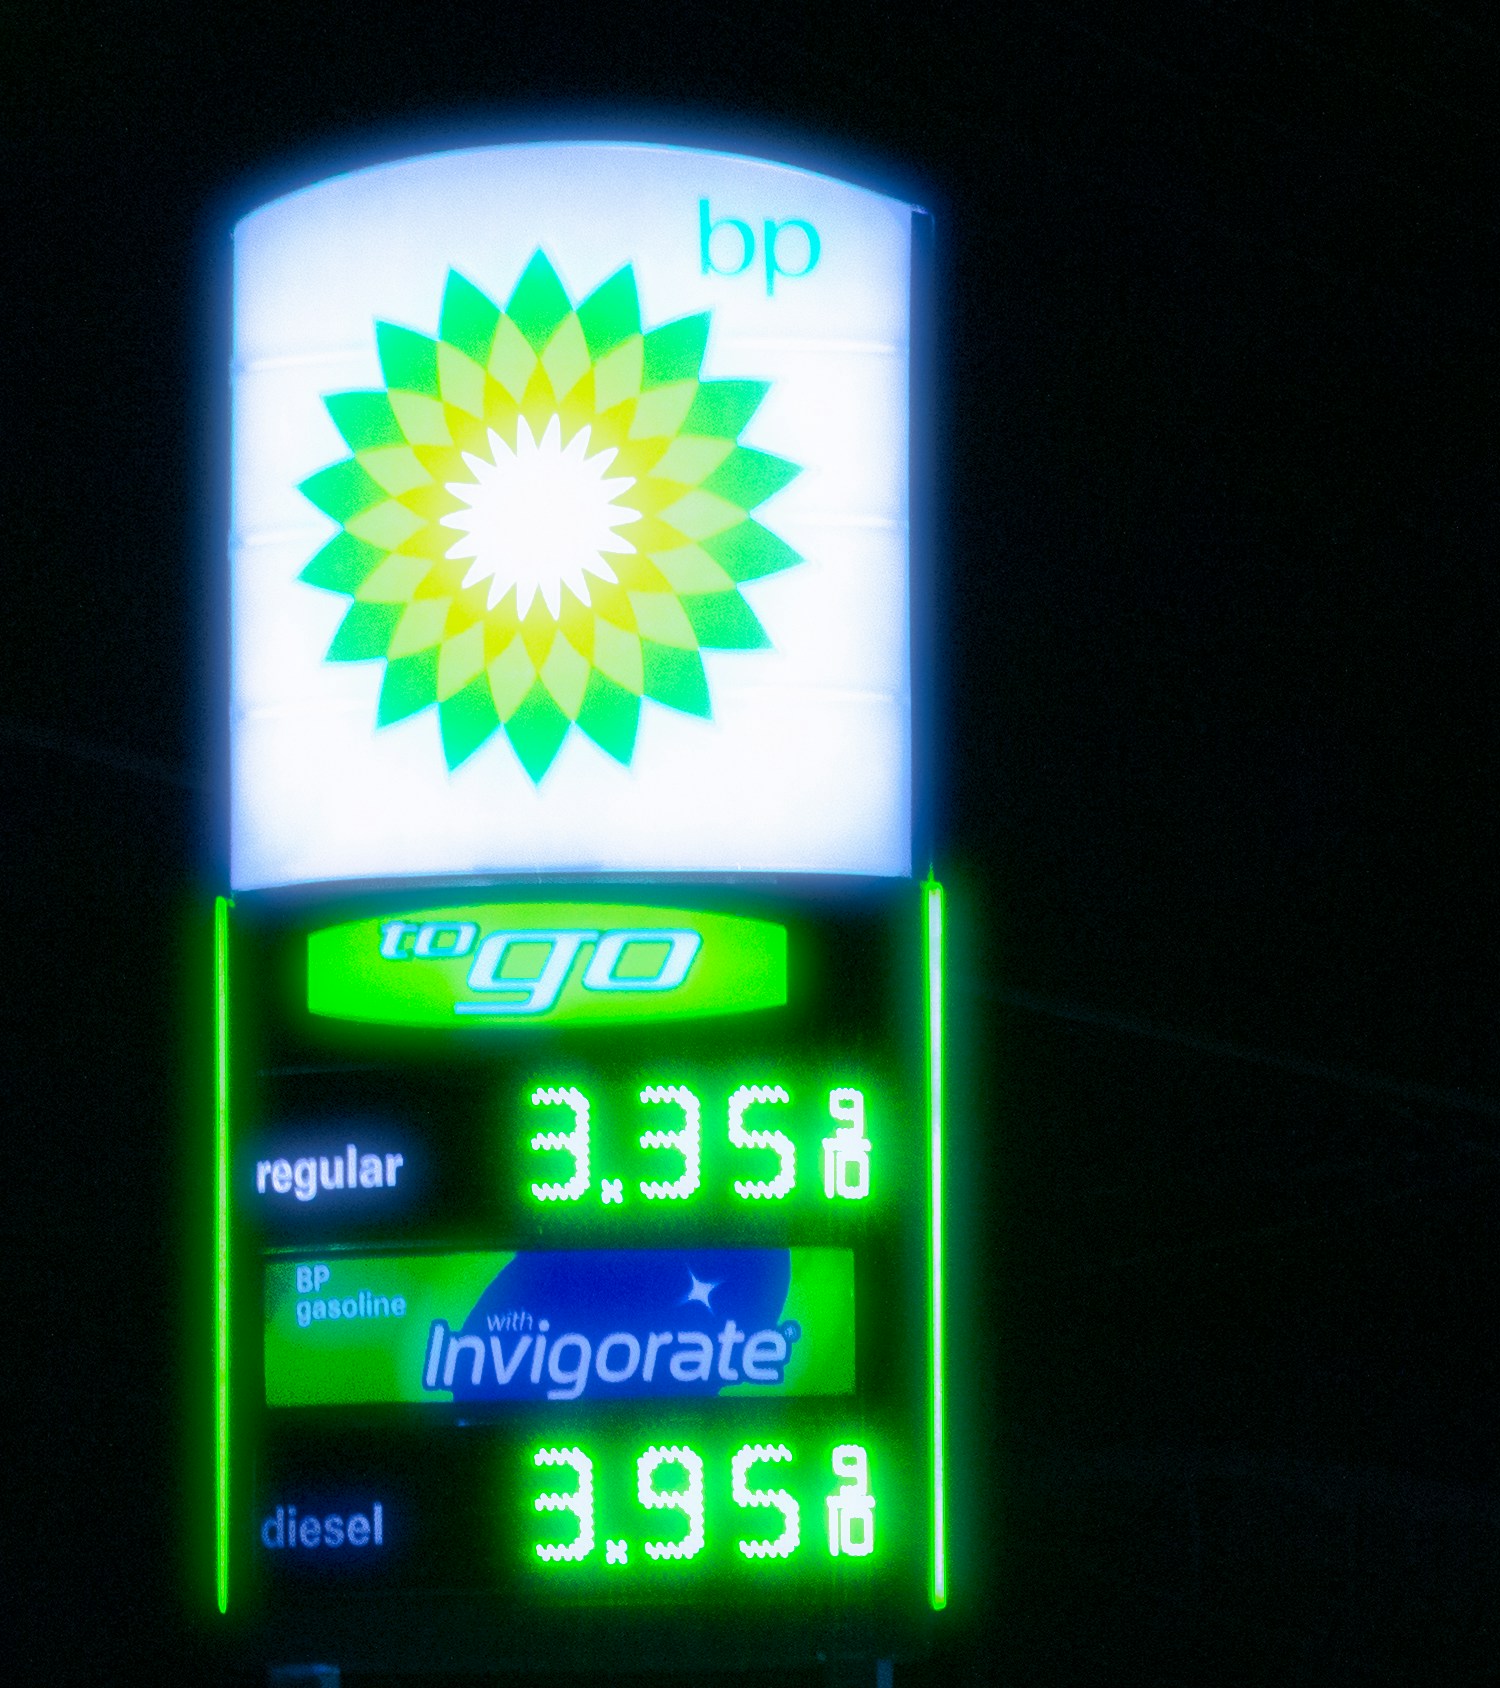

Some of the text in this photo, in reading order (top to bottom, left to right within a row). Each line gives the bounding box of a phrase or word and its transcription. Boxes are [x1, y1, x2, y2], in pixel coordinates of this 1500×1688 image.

[697, 195, 823, 298] bp
[380, 918, 703, 1016] to go
[256, 1143, 405, 1202] regular
[530, 1085, 797, 1205] 3.35
[296, 1263, 330, 1294] BP
[296, 1288, 407, 1328] gasoline
[486, 1311, 534, 1333] with
[261, 1501, 384, 1550] diesel
[533, 1443, 801, 1565] 3.95
